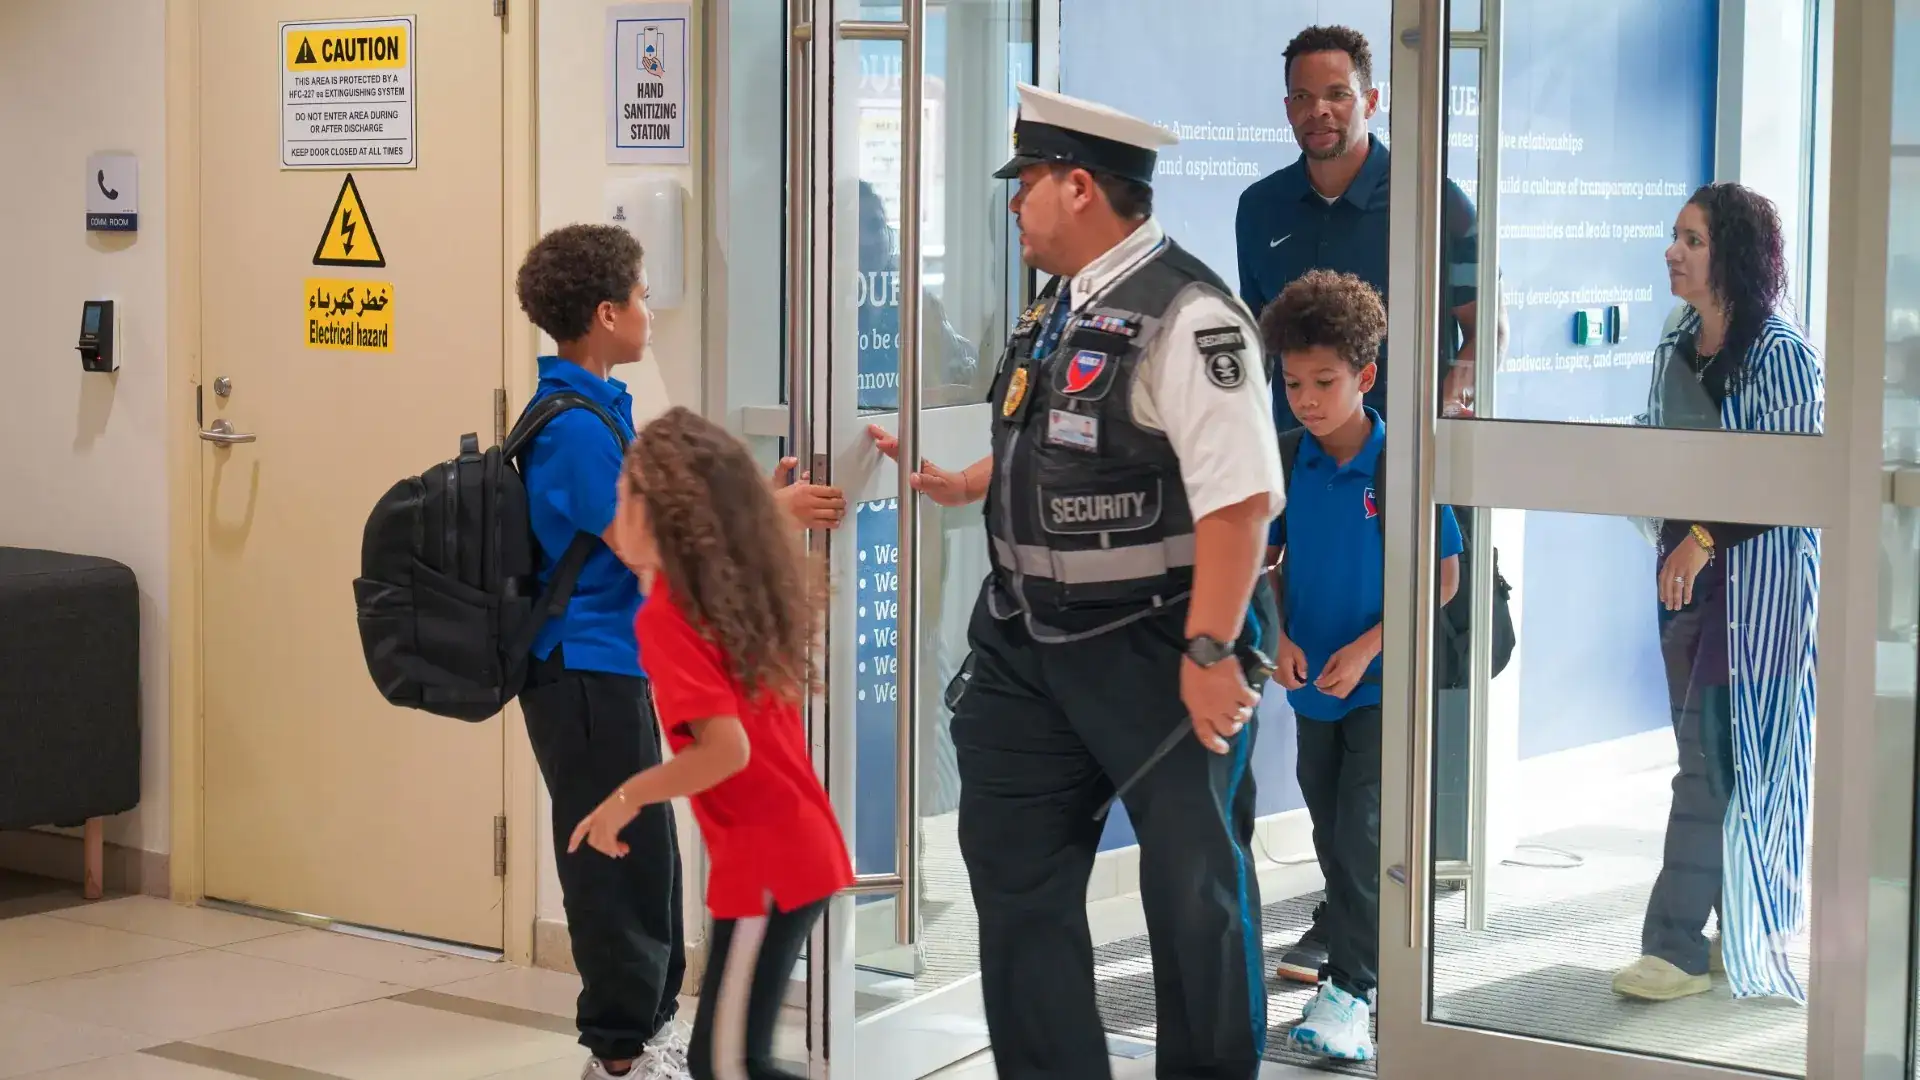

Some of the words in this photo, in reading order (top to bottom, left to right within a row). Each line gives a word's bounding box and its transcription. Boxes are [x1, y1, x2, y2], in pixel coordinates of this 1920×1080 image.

[322, 36, 399, 62] CAUTION
[295, 77, 310, 86] THIS
[311, 76, 331, 85] AREA
[331, 76, 338, 85] IS
[339, 75, 381, 85] PROTECTED
[383, 74, 392, 83] BY
[393, 74, 398, 83] A
[637, 82, 664, 99] HAND
[289, 89, 315, 99] HFC-227
[325, 87, 376, 98] EXTINGUISHING
[377, 87, 405, 96] SYSTEM
[295, 112, 306, 121] DO
[308, 112, 322, 121] NOT
[324, 111, 347, 121] ENTER
[349, 111, 369, 120] AREA
[371, 110, 399, 120] DURING
[624, 103, 677, 120] SANITIZING
[310, 125, 320, 134] OR
[321, 124, 343, 134] AFTER
[344, 123, 384, 133] DISCHARGE
[630, 123, 670, 141] STATION
[1172, 120, 1234, 141] American
[291, 148, 309, 157] KEEP
[310, 148, 330, 157] DOOR
[330, 147, 358, 156] CLOSED
[359, 147, 367, 156] AT
[368, 146, 382, 156] ALL
[382, 146, 403, 156] TIMES
[1518, 131, 1584, 156] relationships
[1157, 155, 1183, 176] and
[1185, 156, 1262, 180] aspirations.
[1500, 176, 1520, 194] uild
[1522, 181, 1529, 194] a
[1531, 177, 1568, 196] culture
[1568, 177, 1579, 196] of
[1580, 179, 1643, 200] transparency
[1645, 179, 1663, 196] and
[1664, 181, 1687, 196] trust
[109, 218, 129, 226] ROOM
[1565, 221, 1584, 239] and
[1585, 221, 1611, 239] leads
[1612, 223, 1622, 239] to
[1621, 221, 1664, 243] personal
[309, 286, 355, 318] كهرباء
[356, 288, 389, 318] خطر
[1527, 286, 1570, 309] develops
[1571, 284, 1633, 306] relationships
[1635, 284, 1653, 302] and
[309, 319, 354, 346] Electrical
[356, 321, 388, 348] hazard
[872, 329, 891, 350] be
[1593, 350, 1612, 368] and
[1050, 491, 1147, 524] SECURITY
[874, 543, 898, 565] We
[874, 571, 898, 593] We
[874, 600, 898, 621] We
[874, 627, 898, 649] We
[874, 655, 897, 676] We
[874, 683, 897, 704] We
